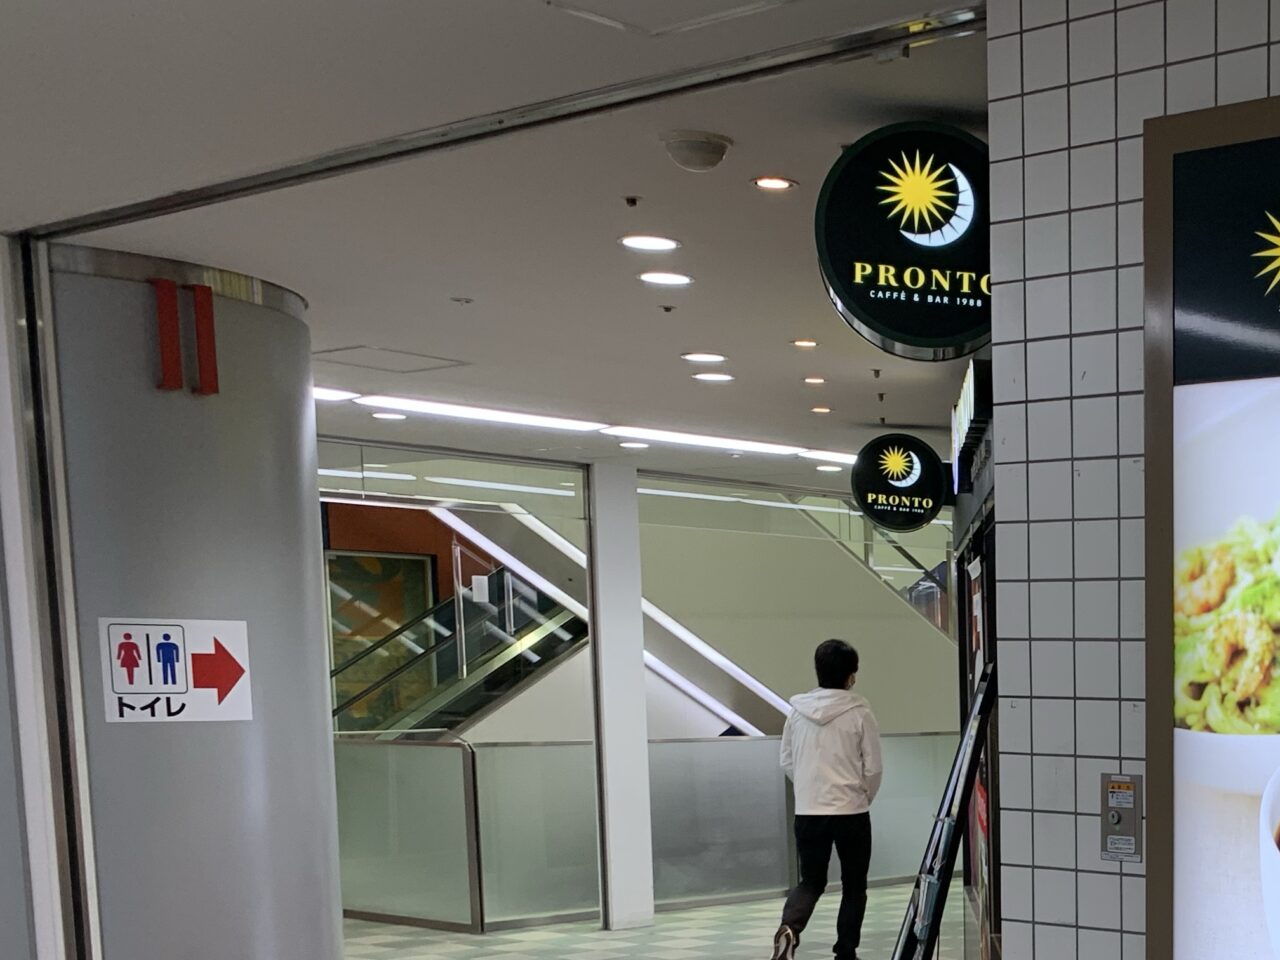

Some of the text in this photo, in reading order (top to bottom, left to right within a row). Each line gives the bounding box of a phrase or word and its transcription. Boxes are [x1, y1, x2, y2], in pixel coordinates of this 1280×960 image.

[927, 295, 949, 304] BAR
[956, 297, 982, 307] 1988
[867, 493, 933, 508] PRONTO
[117, 696, 187, 718] トイレ
